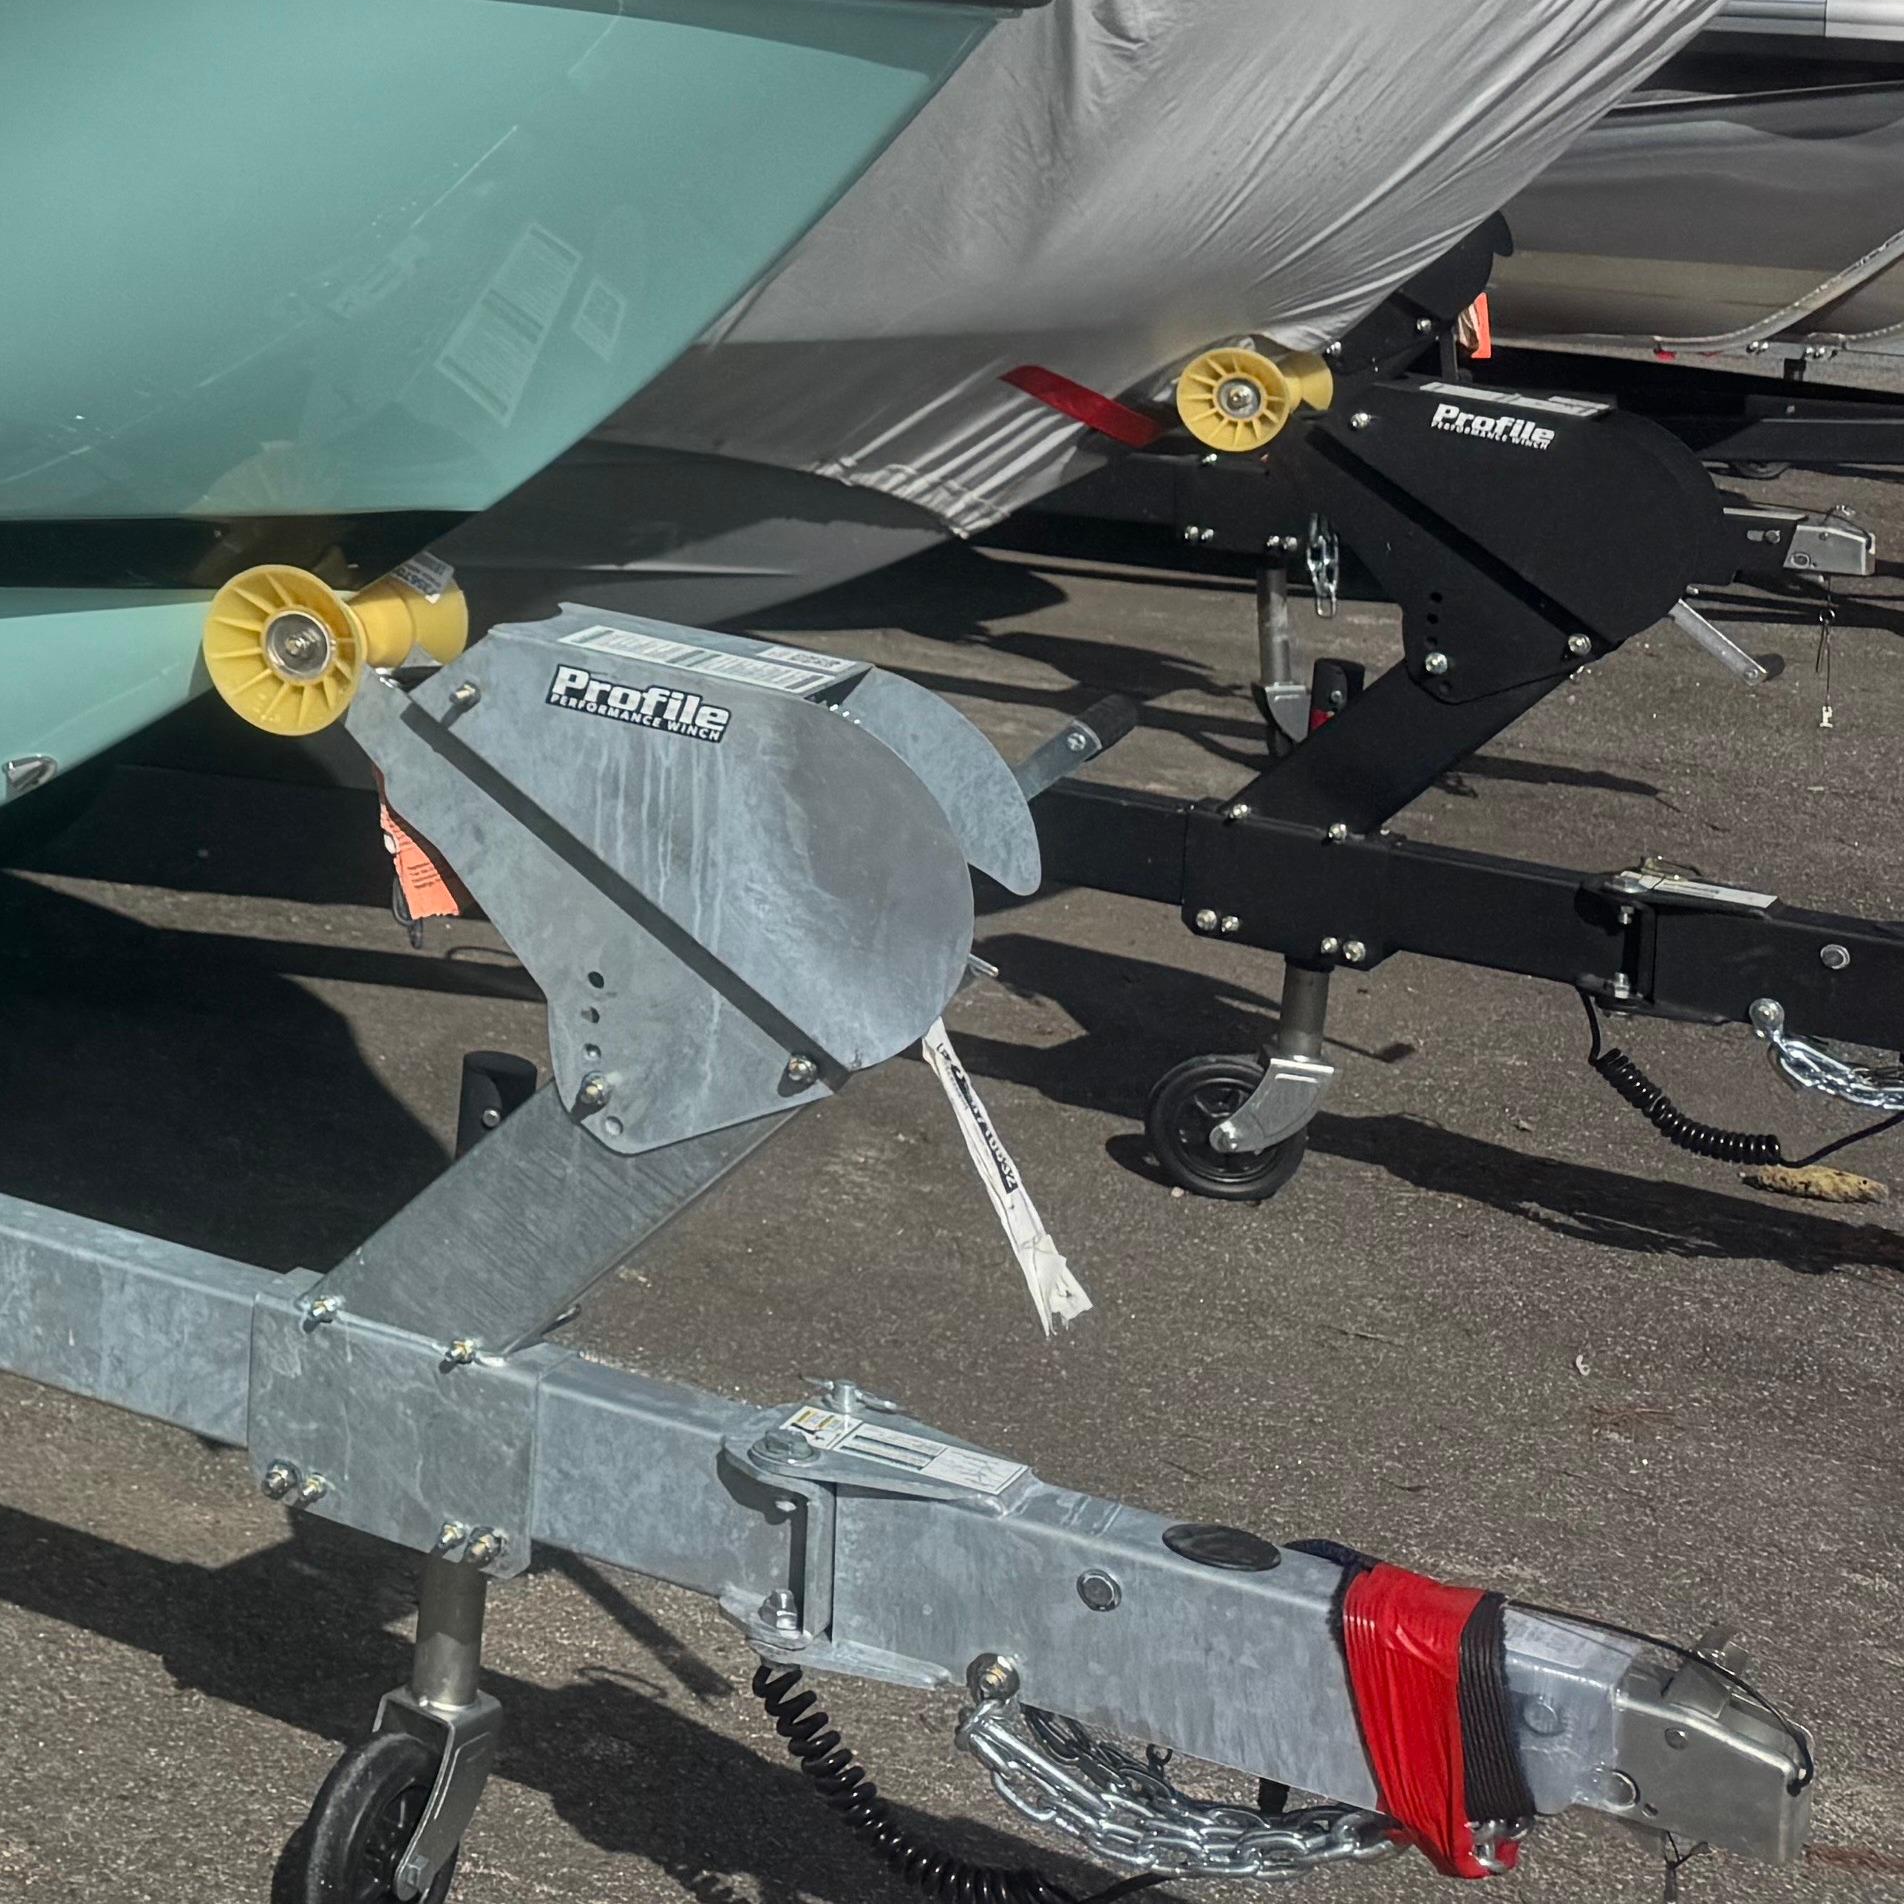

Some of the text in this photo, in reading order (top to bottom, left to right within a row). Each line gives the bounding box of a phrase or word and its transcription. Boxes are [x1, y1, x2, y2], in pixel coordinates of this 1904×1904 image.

[1431, 421, 1551, 450] PERFORMANCE WINCH
[1433, 403, 1555, 442] Profile
[550, 694, 721, 741] PERFORMANCE WINCH
[552, 665, 730, 730] Profile
